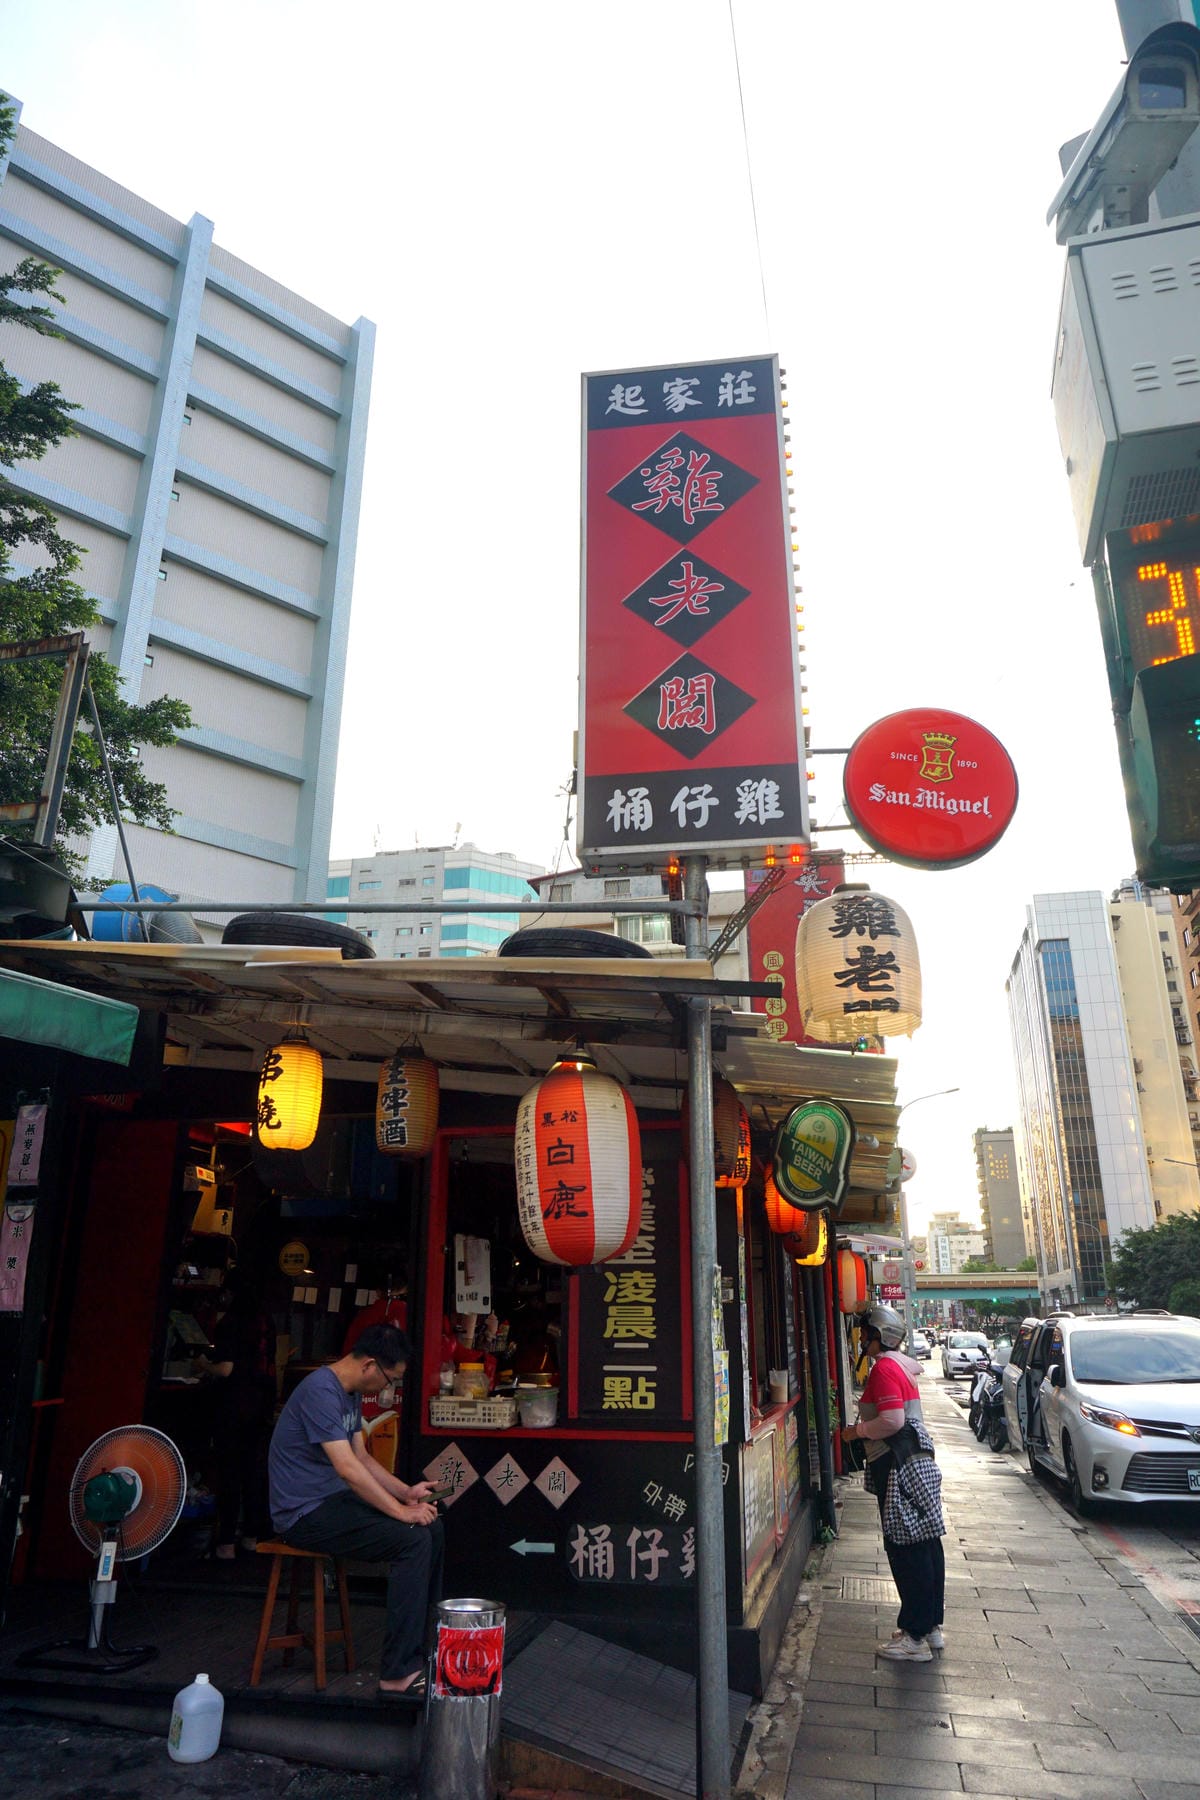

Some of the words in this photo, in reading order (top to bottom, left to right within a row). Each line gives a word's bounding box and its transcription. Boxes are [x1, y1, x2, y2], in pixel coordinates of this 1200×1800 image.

[605, 370, 758, 415] 起家莊
[1138, 562, 1200, 666] 3
[890, 751, 919, 762] SINCE
[956, 759, 978, 769] 1890
[605, 776, 785, 834] 桶仔雞
[868, 782, 911, 806] San
[912, 787, 991, 815] Miguel
[257, 1050, 284, 1130] 串燒
[380, 1057, 409, 1147] 生啤酒
[541, 1109, 580, 1128] 黑松
[542, 1137, 589, 1220] 白鹿
[790, 1138, 833, 1174] TAIWAN
[793, 1154, 823, 1181] BEER
